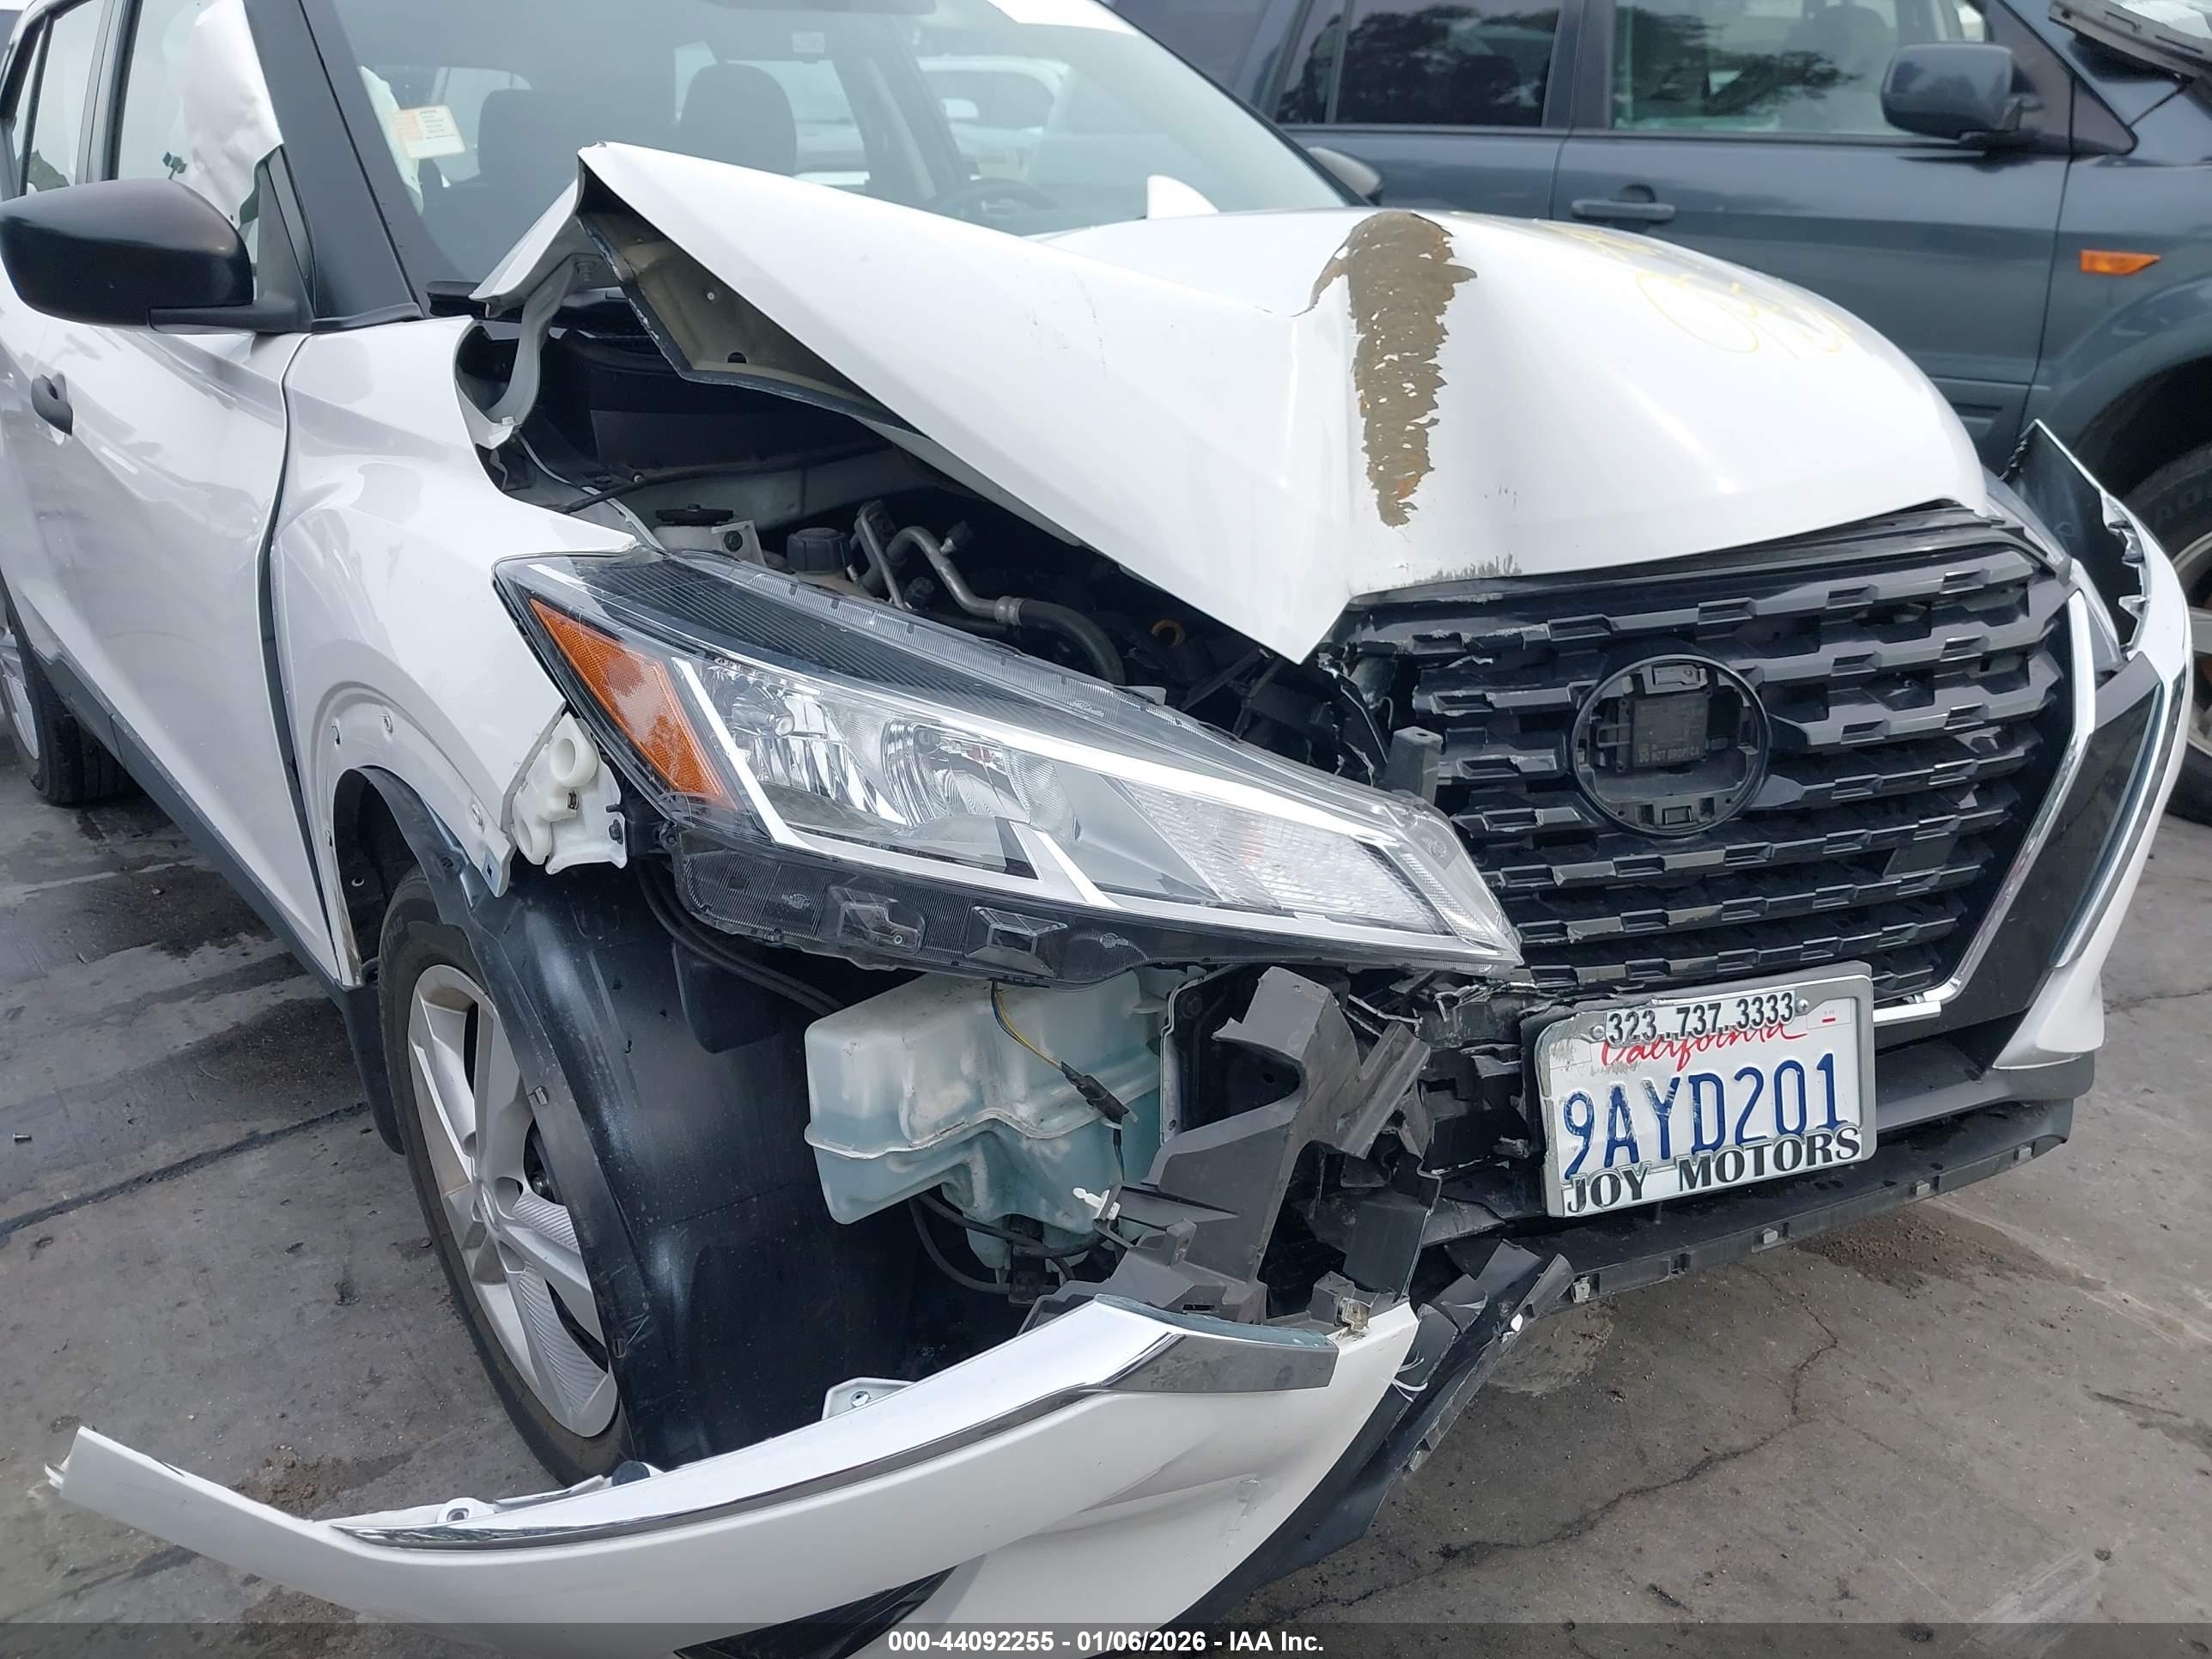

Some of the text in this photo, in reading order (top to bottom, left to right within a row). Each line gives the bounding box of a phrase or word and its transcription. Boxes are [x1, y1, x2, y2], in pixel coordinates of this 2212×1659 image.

[1564, 1053, 1849, 1180] 9AYD201
[1567, 1127, 1860, 1213] JOY MOTORS
